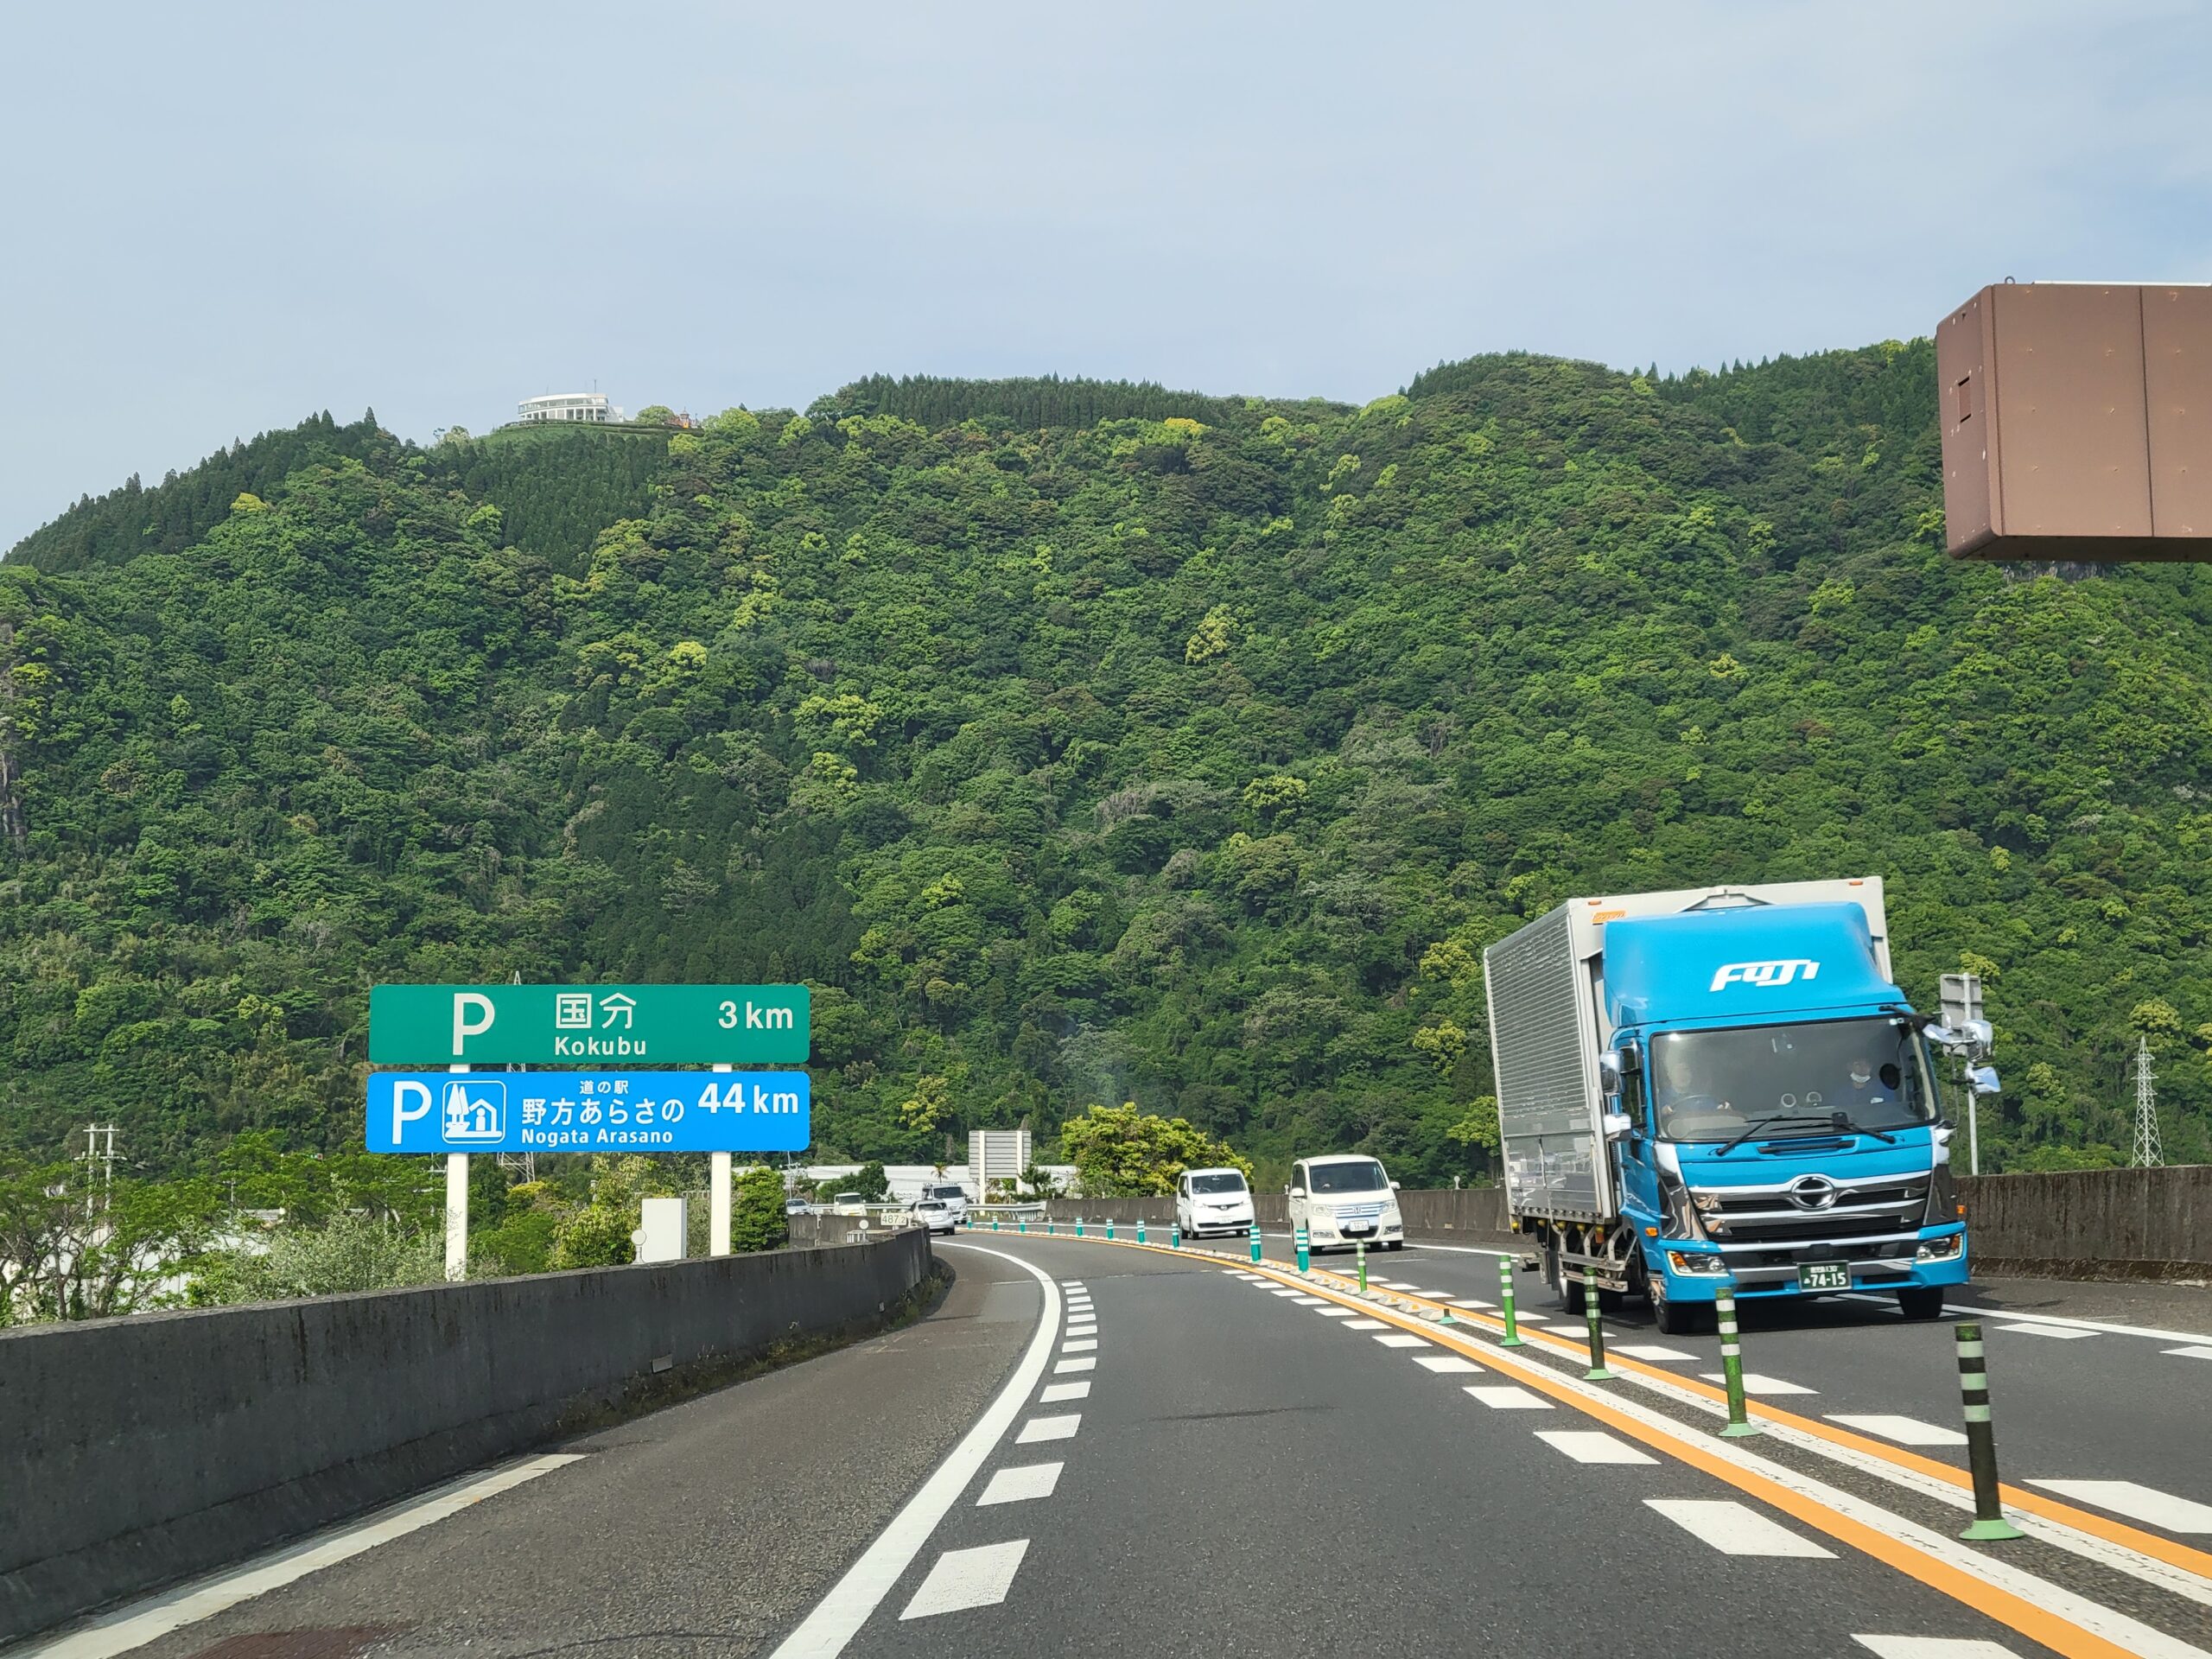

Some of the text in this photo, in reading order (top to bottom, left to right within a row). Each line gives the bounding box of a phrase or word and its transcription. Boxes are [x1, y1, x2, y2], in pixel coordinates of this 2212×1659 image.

[452, 993, 495, 1056] P
[556, 992, 637, 1029] 国分
[555, 1036, 646, 1056] Kokubu
[579, 1080, 628, 1095] 道の駅
[391, 1080, 432, 1145] P
[522, 1097, 684, 1126] 野方あらさの
[522, 1128, 673, 1147] Nogata Arasano
